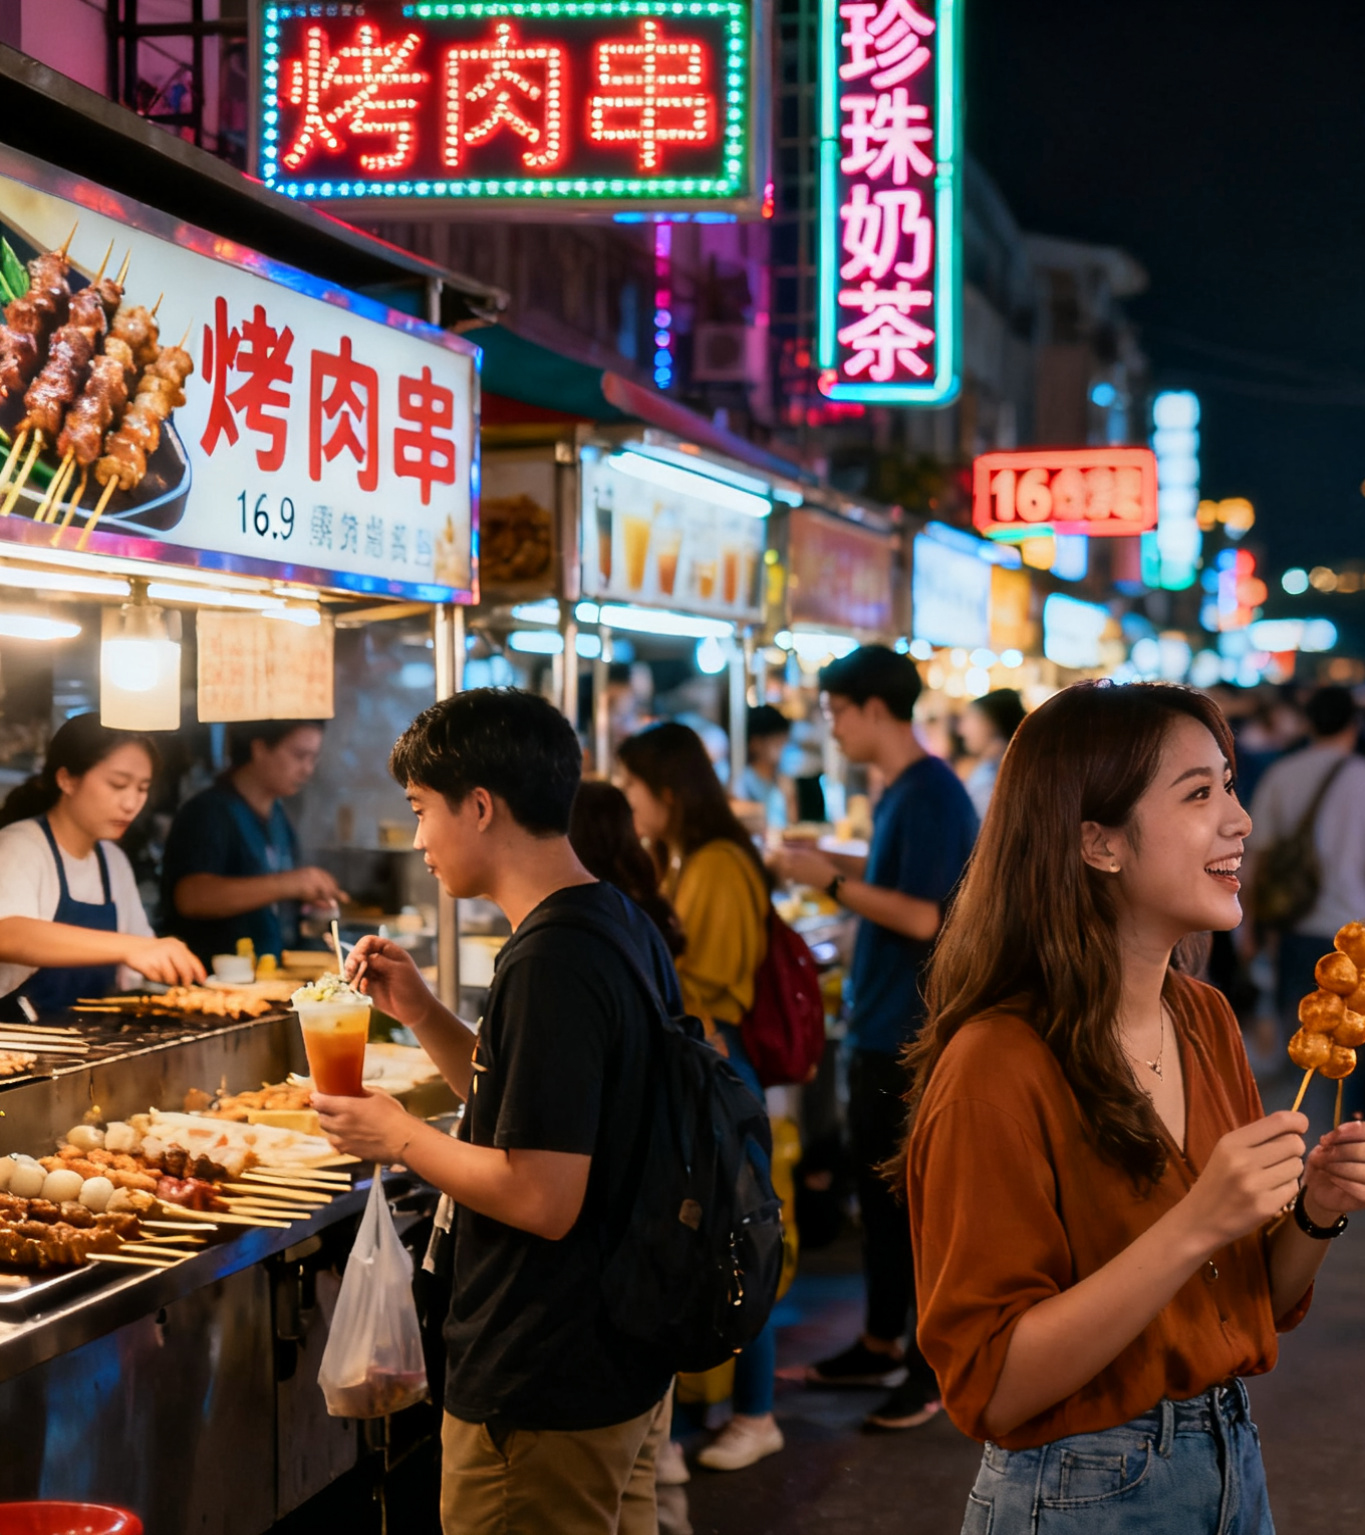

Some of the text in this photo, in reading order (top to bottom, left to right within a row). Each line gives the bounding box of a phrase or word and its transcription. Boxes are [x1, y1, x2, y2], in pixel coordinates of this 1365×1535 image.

[282, 20, 712, 170] 烤肉串
[838, 0, 936, 382] 珍珠奶茶
[200, 295, 456, 506] 烤肉串
[237, 489, 295, 541] 16.9
